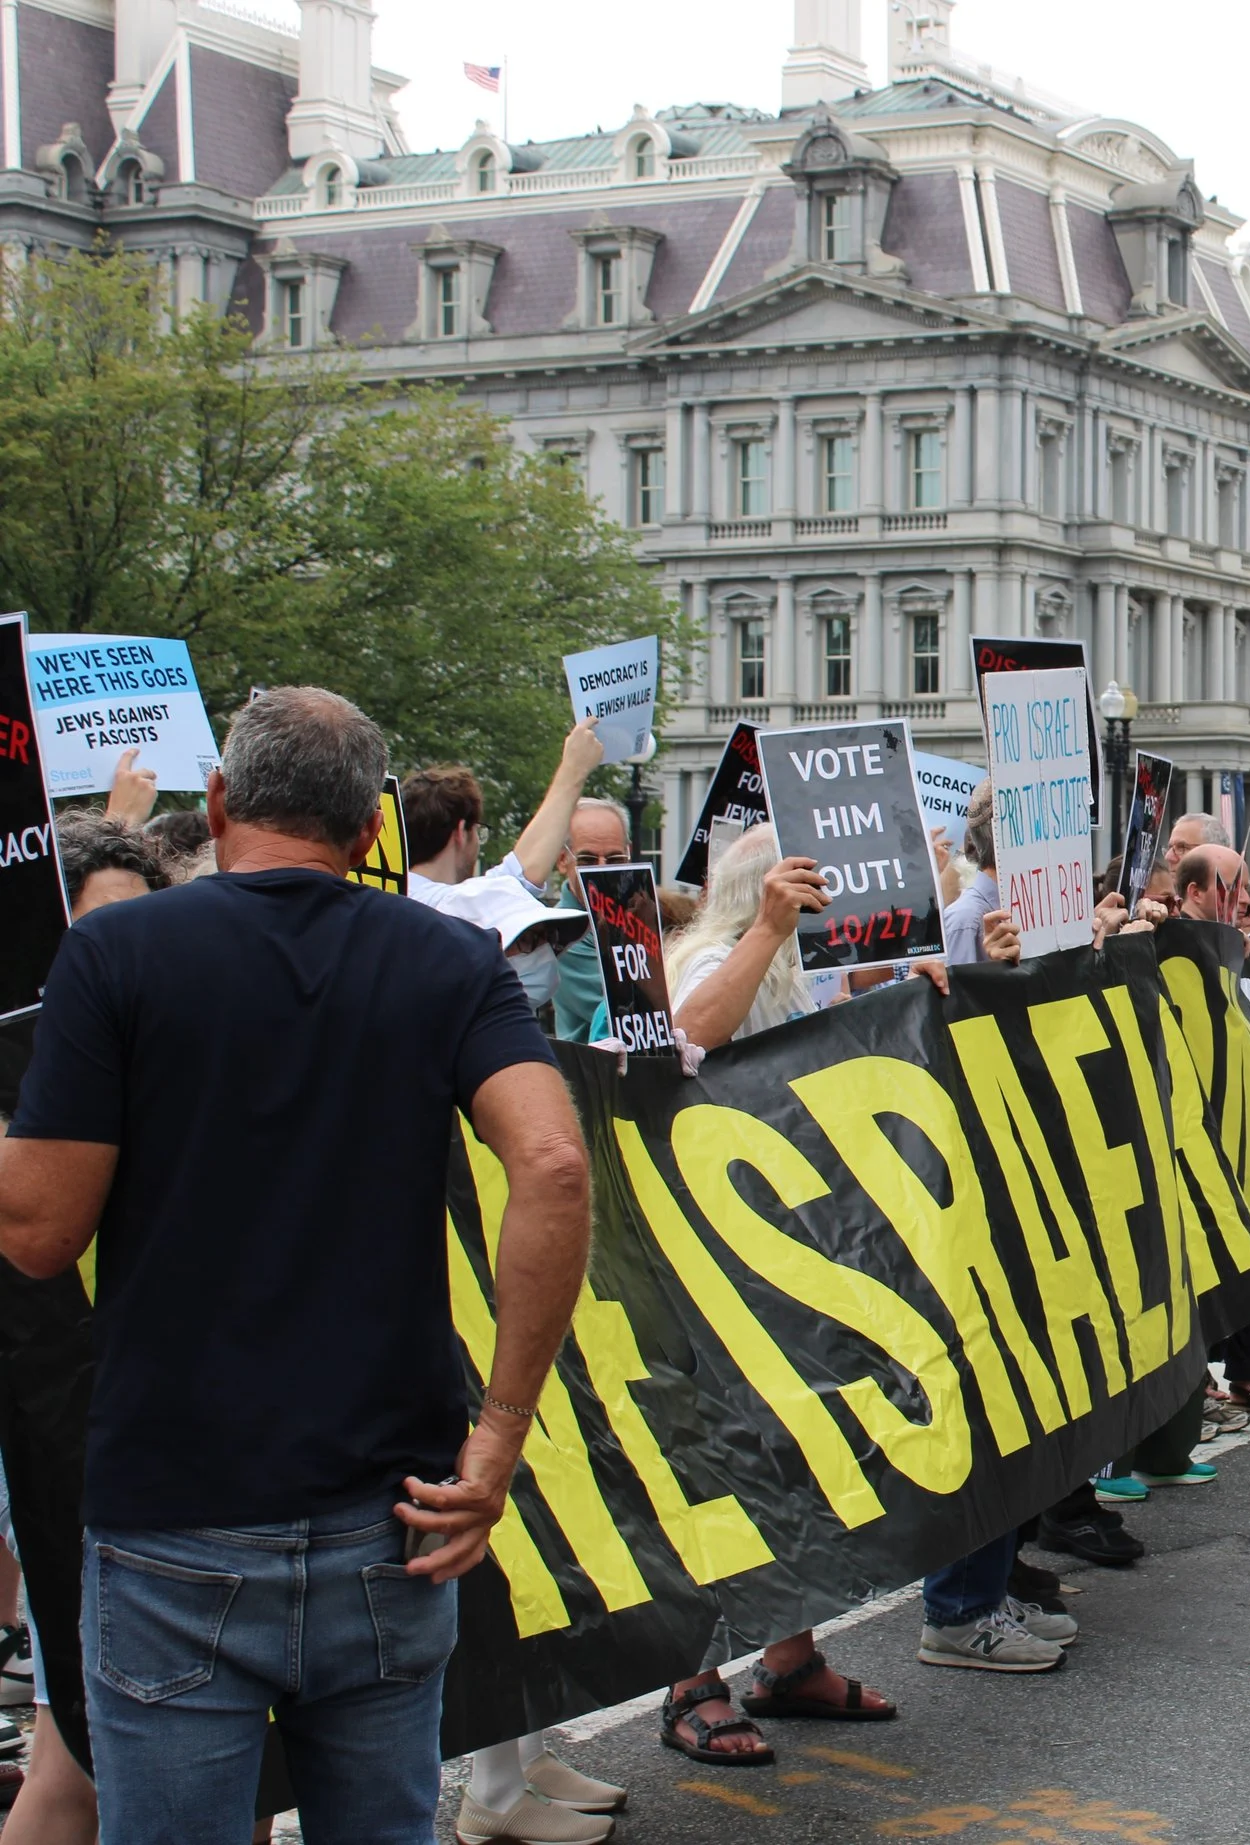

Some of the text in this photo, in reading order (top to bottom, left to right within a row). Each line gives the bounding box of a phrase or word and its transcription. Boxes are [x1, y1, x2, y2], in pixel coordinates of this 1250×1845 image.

[36, 645, 155, 675] WE'VE SEEN
[579, 660, 648, 692] DEMOCRACY IS
[37, 667, 188, 701] HERE THIS GOES
[585, 688, 651, 719] A JEWISH VALUE
[56, 704, 170, 735] JEWS AGAINST
[85, 726, 158, 749] FASCISTS
[992, 698, 1083, 764] PRO ISRAEL
[789, 743, 885, 783] VOTE
[917, 770, 976, 796] OCRACY
[812, 802, 884, 840] HIM
[998, 786, 1024, 849] PRO
[1023, 780, 1050, 843] TWO
[1049, 776, 1089, 841] STATES
[818, 858, 906, 897] OUT!
[1010, 859, 1089, 932] ANTI BIBI
[587, 880, 660, 962] DISASTER
[824, 908, 913, 947] 10/27
[611, 943, 651, 982] FOR
[615, 1010, 675, 1053] ISRAEL
[613, 984, 1192, 1532] ISRAEL
